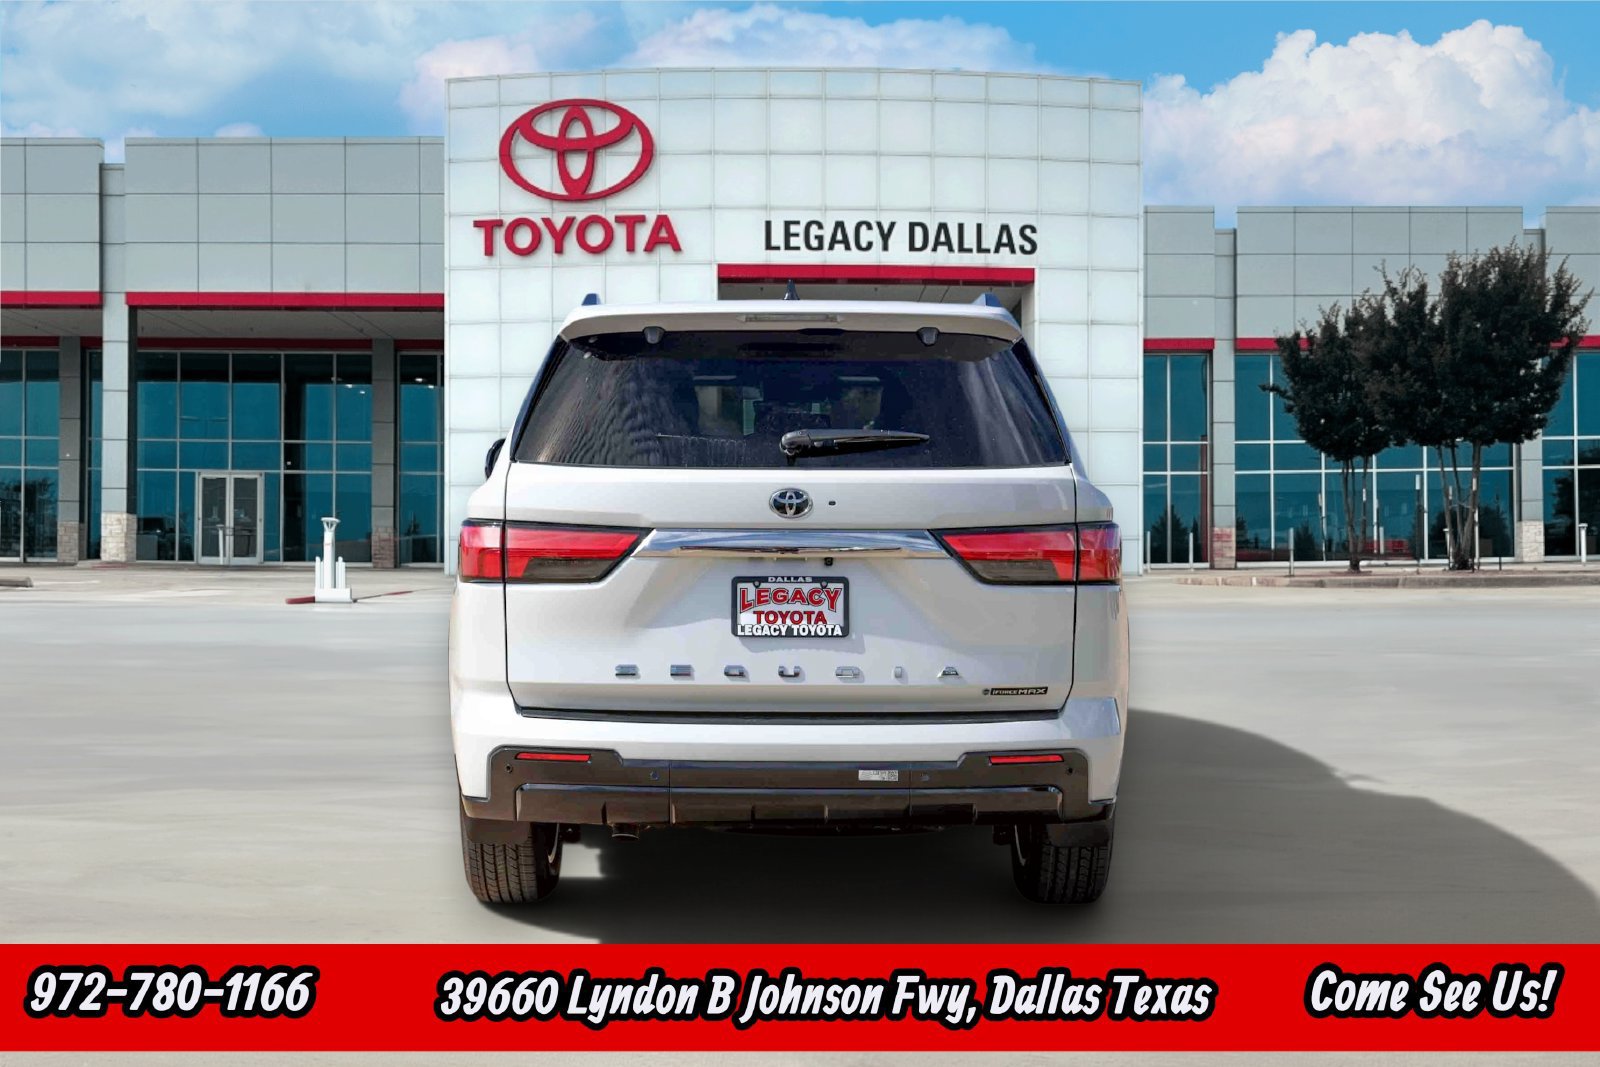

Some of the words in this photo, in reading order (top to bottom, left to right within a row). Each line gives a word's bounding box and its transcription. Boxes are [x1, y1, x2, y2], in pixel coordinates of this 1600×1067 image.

[473, 215, 681, 256] TOYOTA
[764, 220, 896, 251] LEGACY
[908, 222, 1038, 254] DALLAS
[740, 587, 842, 613] LEGACY
[737, 624, 787, 636] LEGACY
[792, 624, 842, 636] TOYOTA
[753, 610, 827, 625] TOYOTA
